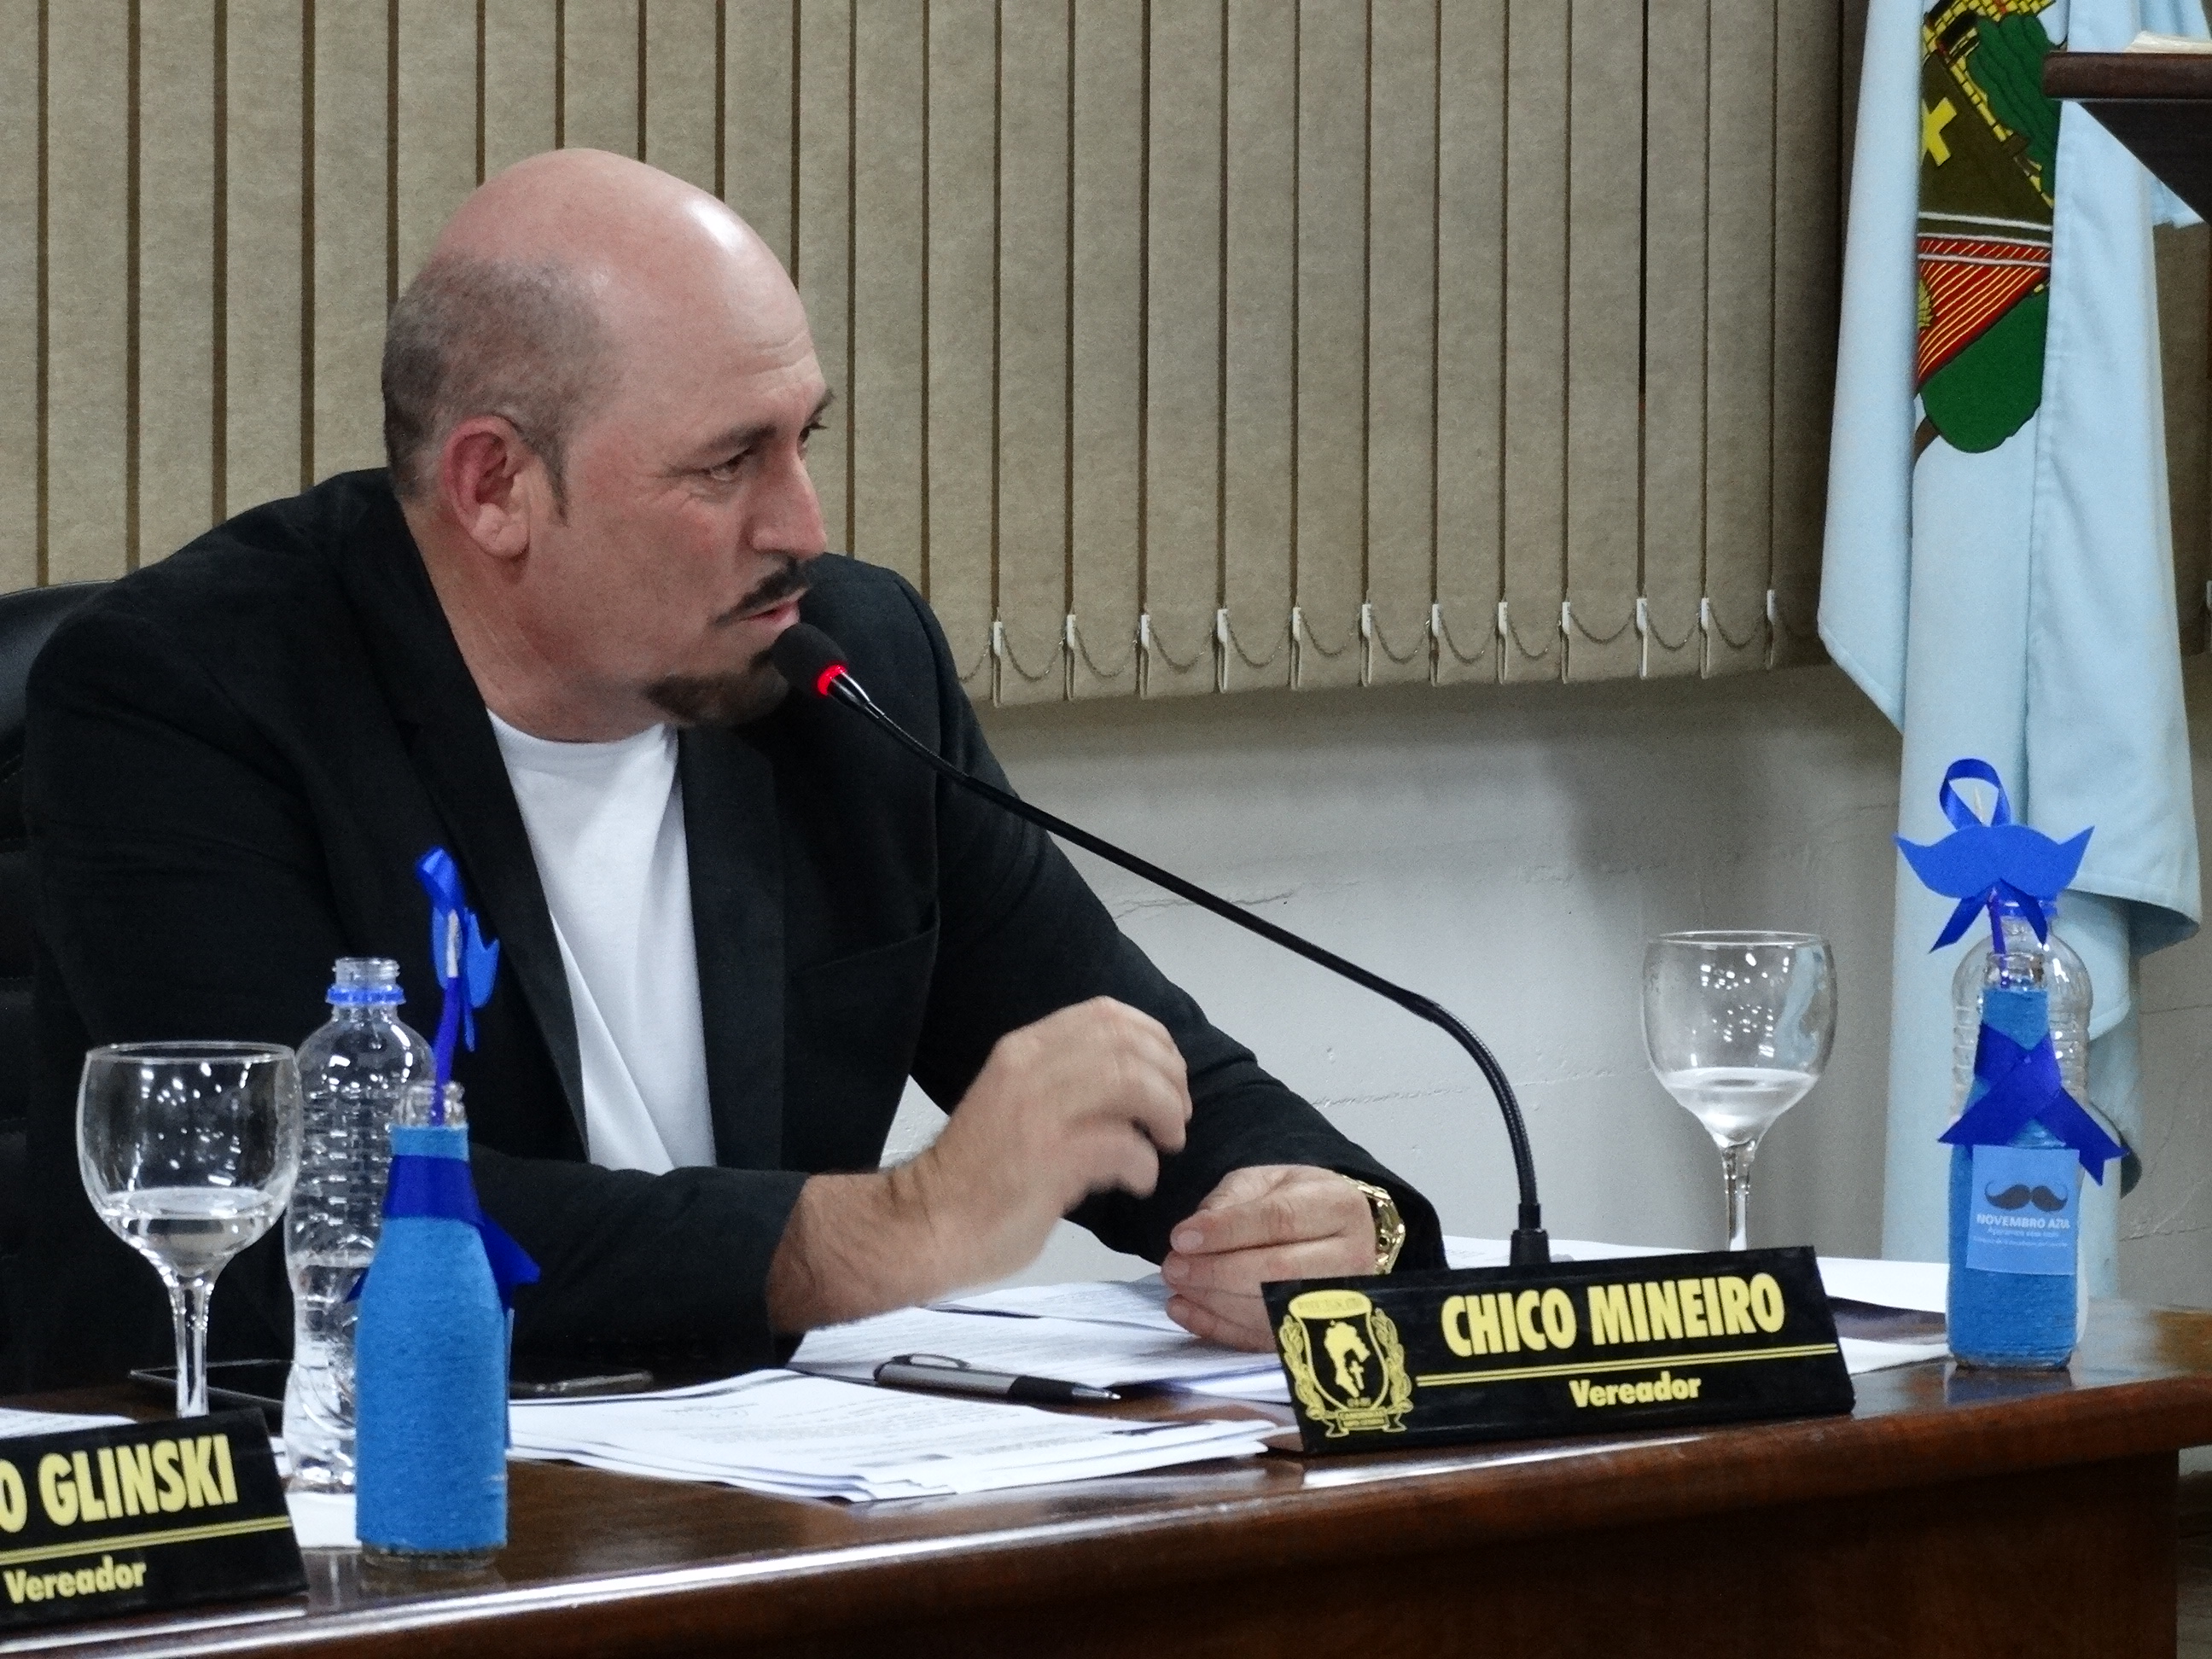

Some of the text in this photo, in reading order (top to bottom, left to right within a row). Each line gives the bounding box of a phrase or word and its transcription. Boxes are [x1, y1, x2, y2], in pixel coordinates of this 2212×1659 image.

[1976, 1214, 2046, 1228] NOVEMBRO
[1441, 1272, 1785, 1358] CHICO MINEIRO
[1569, 1371, 1702, 1408] Vereador
[38, 1434, 238, 1526] GLINSKI
[3, 1554, 148, 1604] Vereador
